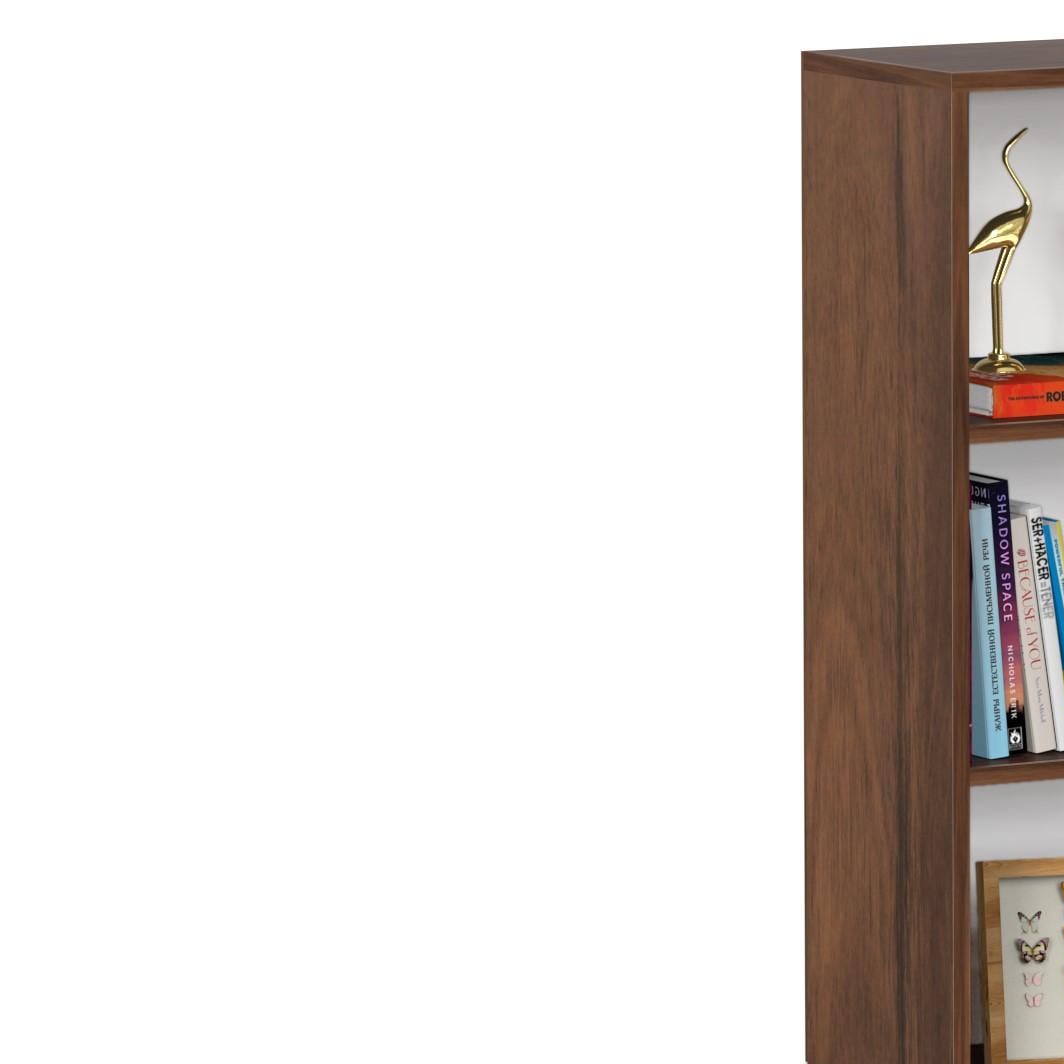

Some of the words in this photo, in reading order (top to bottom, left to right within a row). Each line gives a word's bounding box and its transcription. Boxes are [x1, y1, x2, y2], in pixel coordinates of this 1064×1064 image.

[981, 538, 990, 561] РЕЧИ
[996, 494, 1010, 565] SHADOW
[1001, 573, 1014, 622] SPACE
[1007, 645, 1017, 694] NICHOLAS
[992, 698, 1002, 732] ЖАНРЫ
